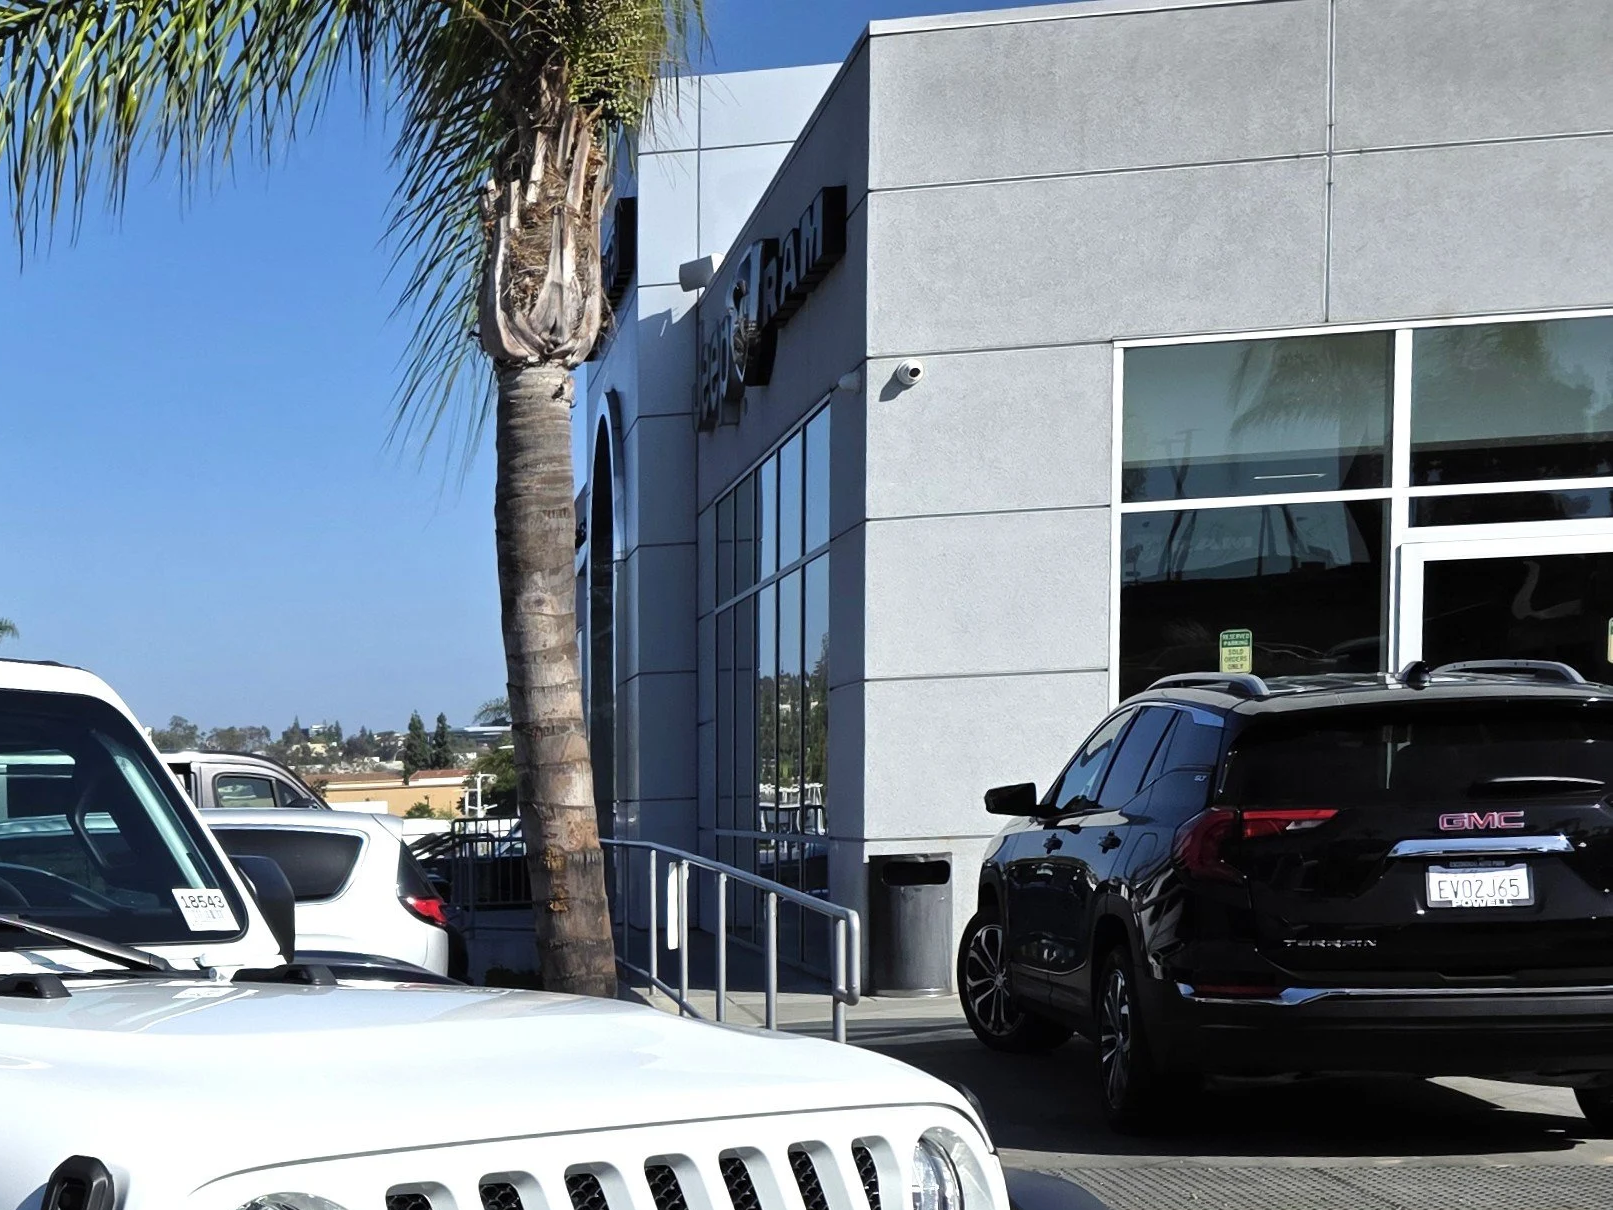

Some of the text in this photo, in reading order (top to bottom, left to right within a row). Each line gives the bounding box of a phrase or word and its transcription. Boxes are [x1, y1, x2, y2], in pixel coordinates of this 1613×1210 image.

[765, 186, 834, 322] RAM
[1439, 810, 1525, 830] GMC
[1438, 879, 1520, 899] EV02J65
[180, 895, 225, 909] 18543
[1283, 939, 1377, 948] TERRAIN
